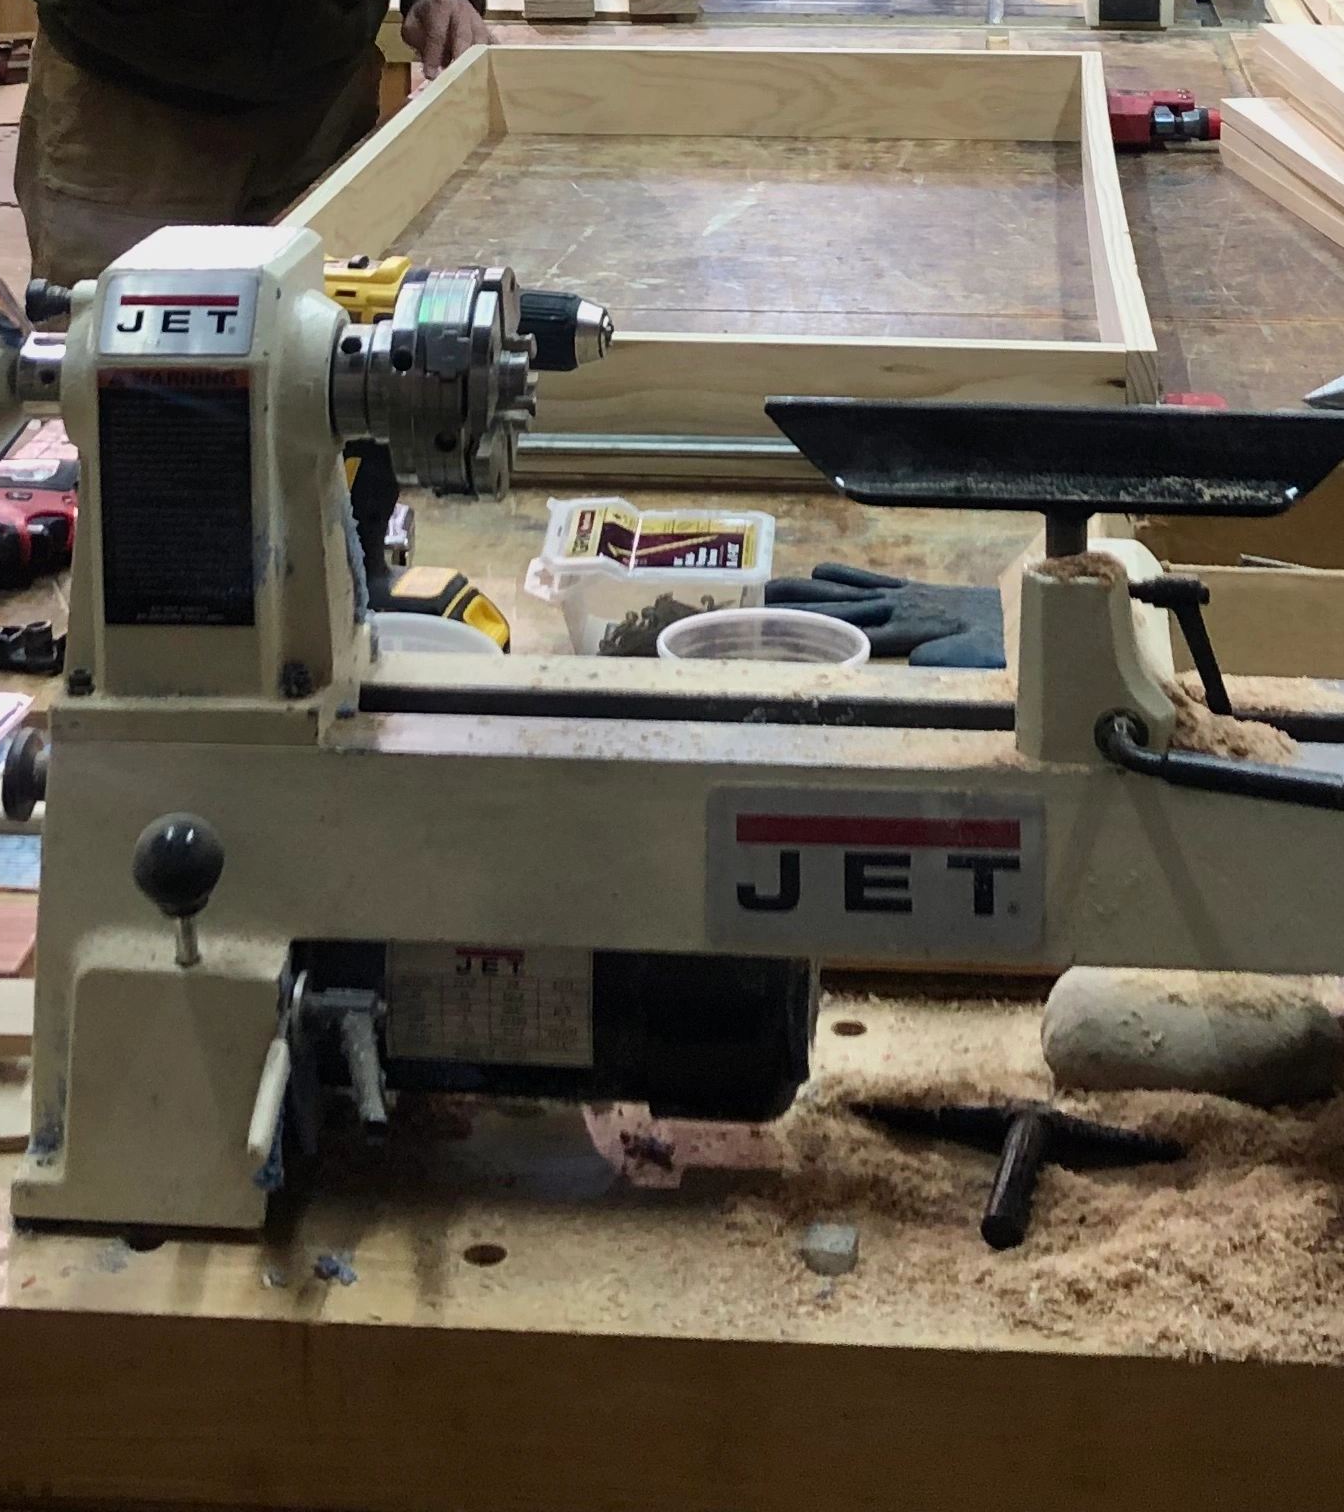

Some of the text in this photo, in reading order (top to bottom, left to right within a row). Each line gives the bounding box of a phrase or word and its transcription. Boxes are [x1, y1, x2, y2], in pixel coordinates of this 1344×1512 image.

[116, 309, 238, 334] JET
[736, 848, 1021, 915] JET
[456, 956, 523, 976] JET
